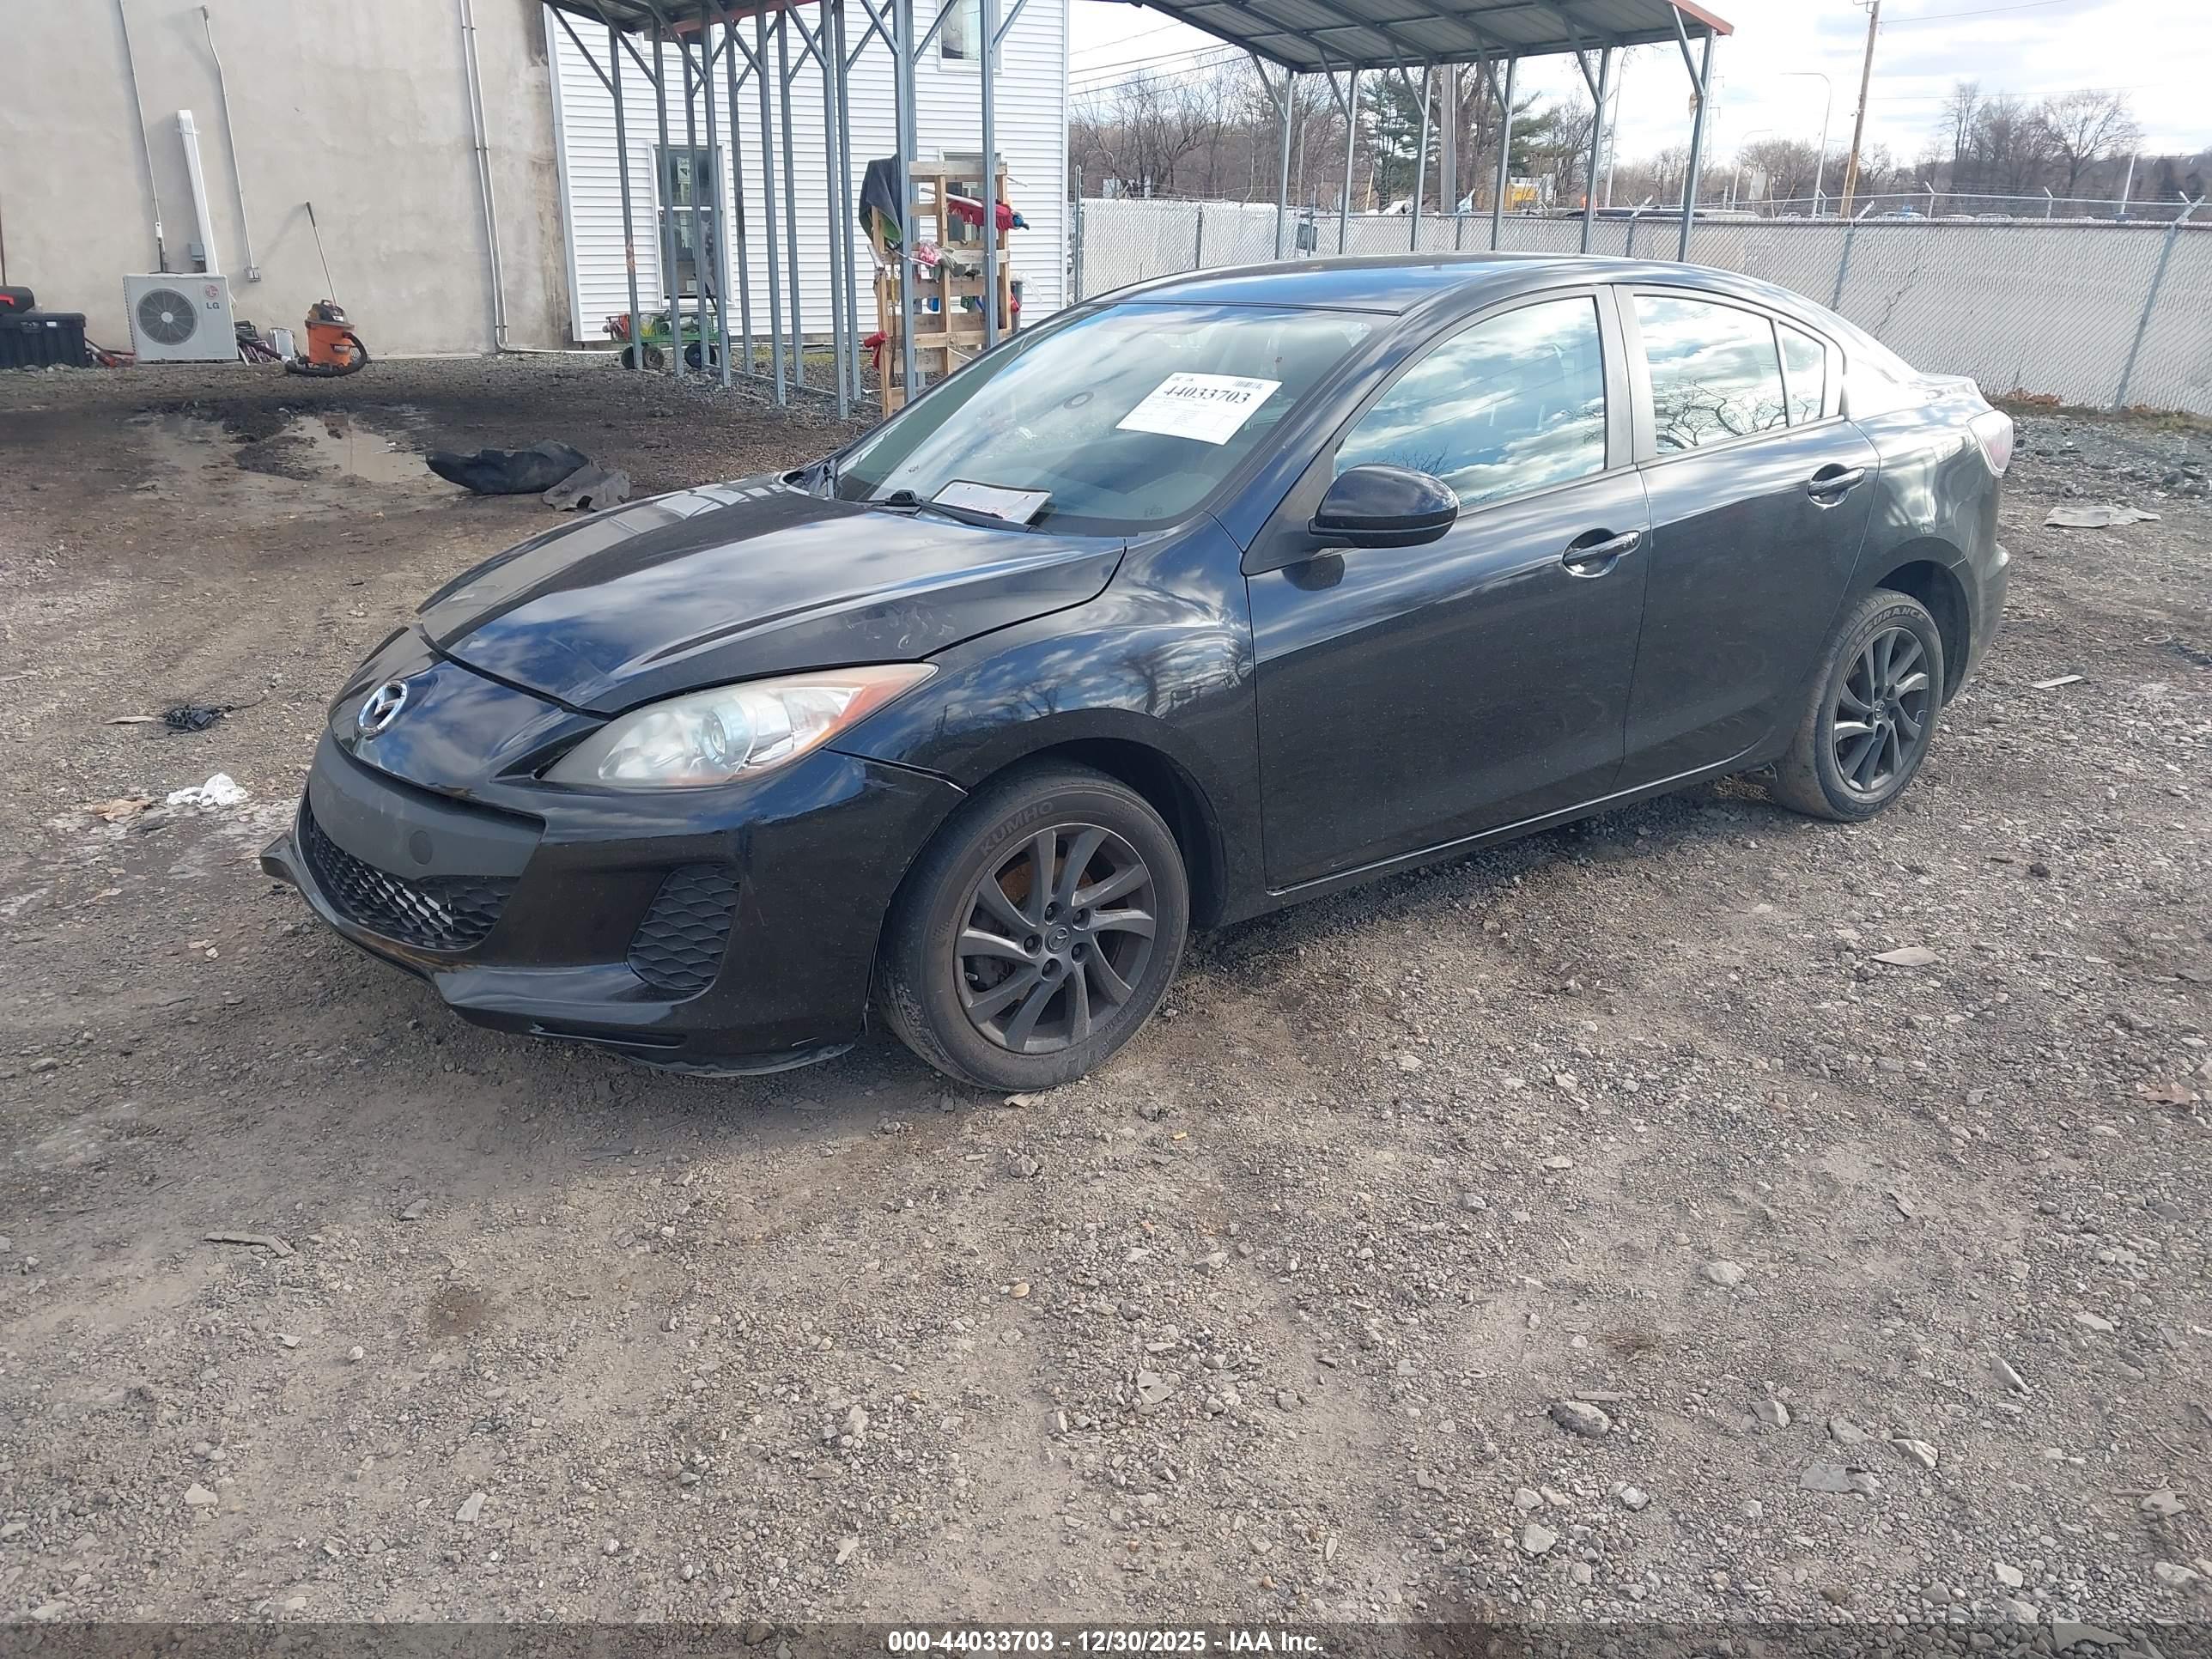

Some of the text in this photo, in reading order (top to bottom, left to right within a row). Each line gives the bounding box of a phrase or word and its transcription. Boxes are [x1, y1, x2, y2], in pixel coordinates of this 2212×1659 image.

[206, 301, 220, 310] LG
[1164, 385, 1251, 404] 44033703
[980, 801, 1053, 858] KUMHO
